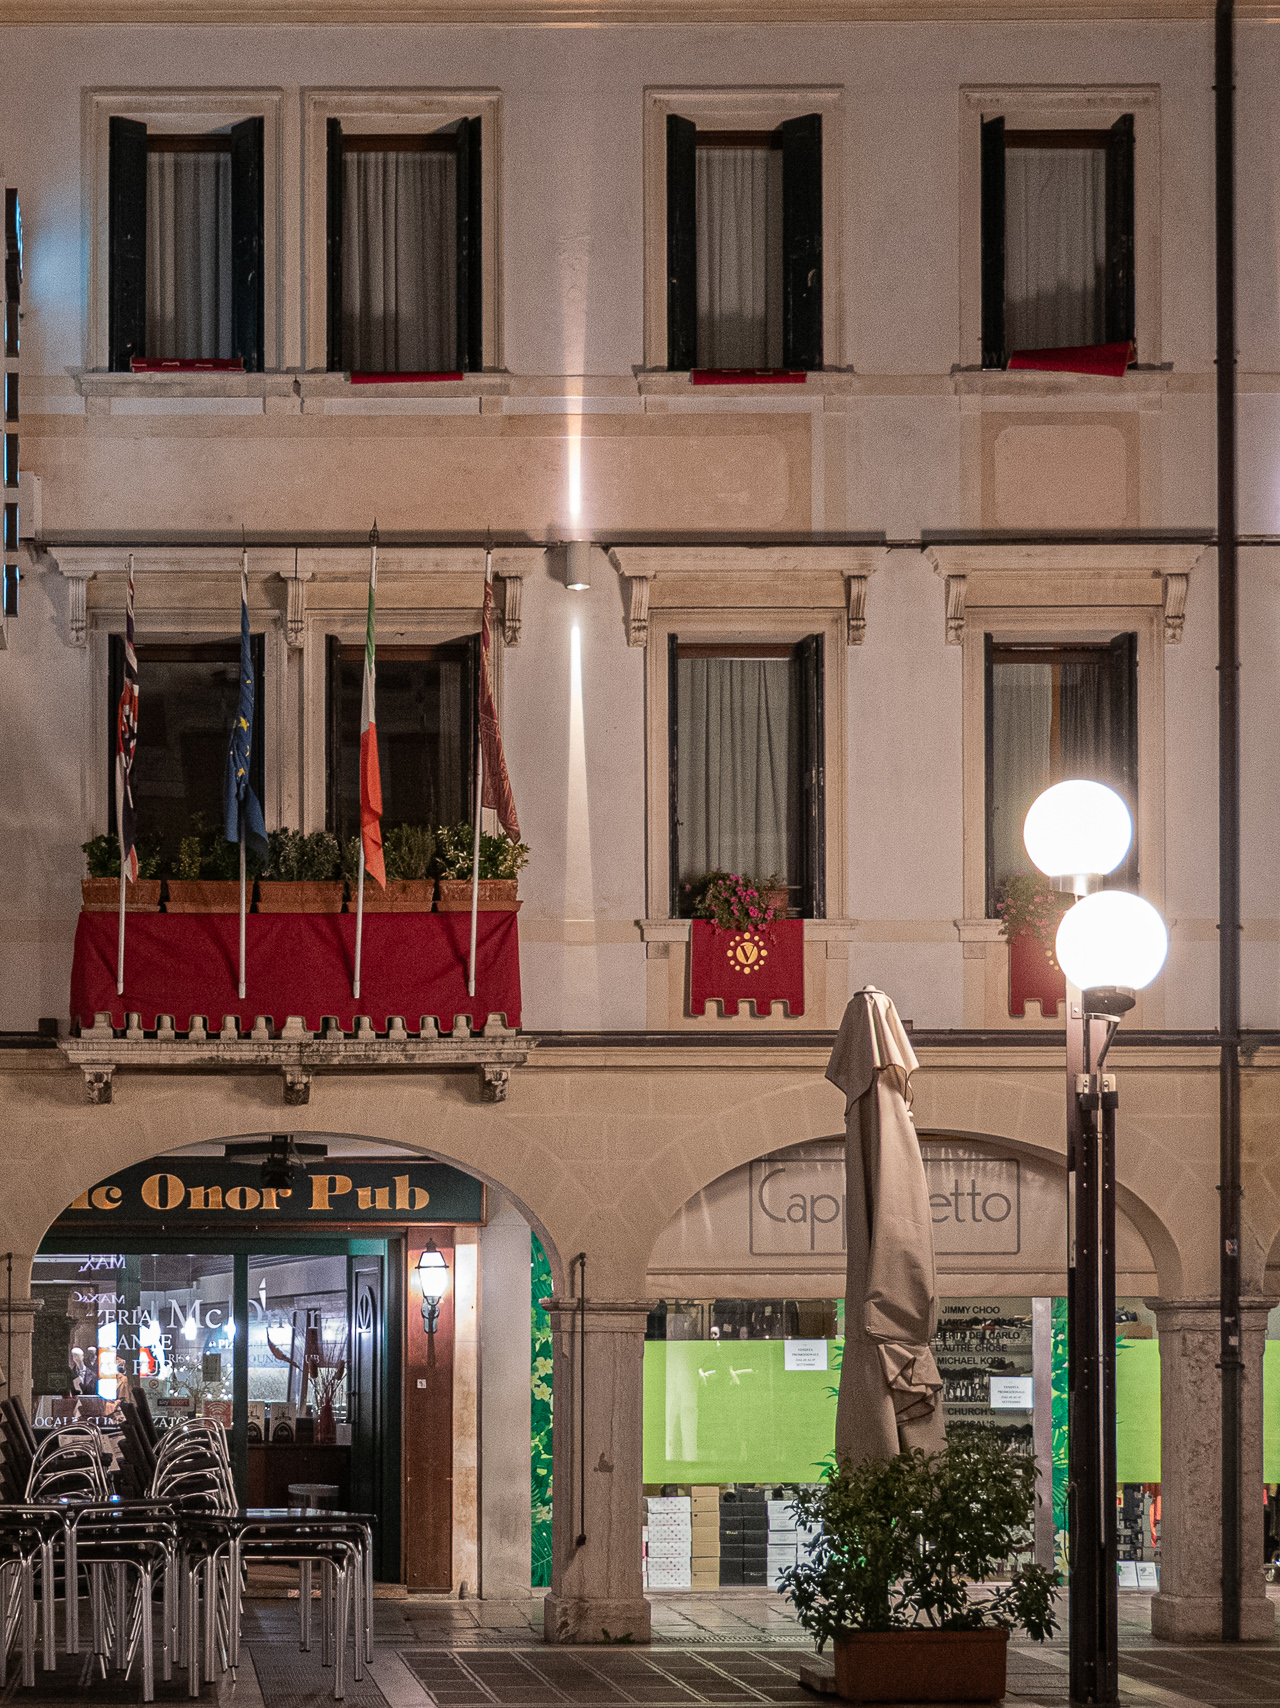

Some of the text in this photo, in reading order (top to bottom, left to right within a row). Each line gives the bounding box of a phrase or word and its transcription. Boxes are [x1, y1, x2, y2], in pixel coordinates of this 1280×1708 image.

[141, 1173, 292, 1211] Onor
[307, 1174, 430, 1211] Pub
[166, 1299, 222, 1329] Mc
[942, 1306, 1000, 1314] JIMMY CHOO
[989, 1332, 1020, 1340] CARLO
[974, 1344, 1008, 1353] CHOSE
[937, 1357, 979, 1365] MICHAEL
[947, 1407, 996, 1416] CHURCH'S
